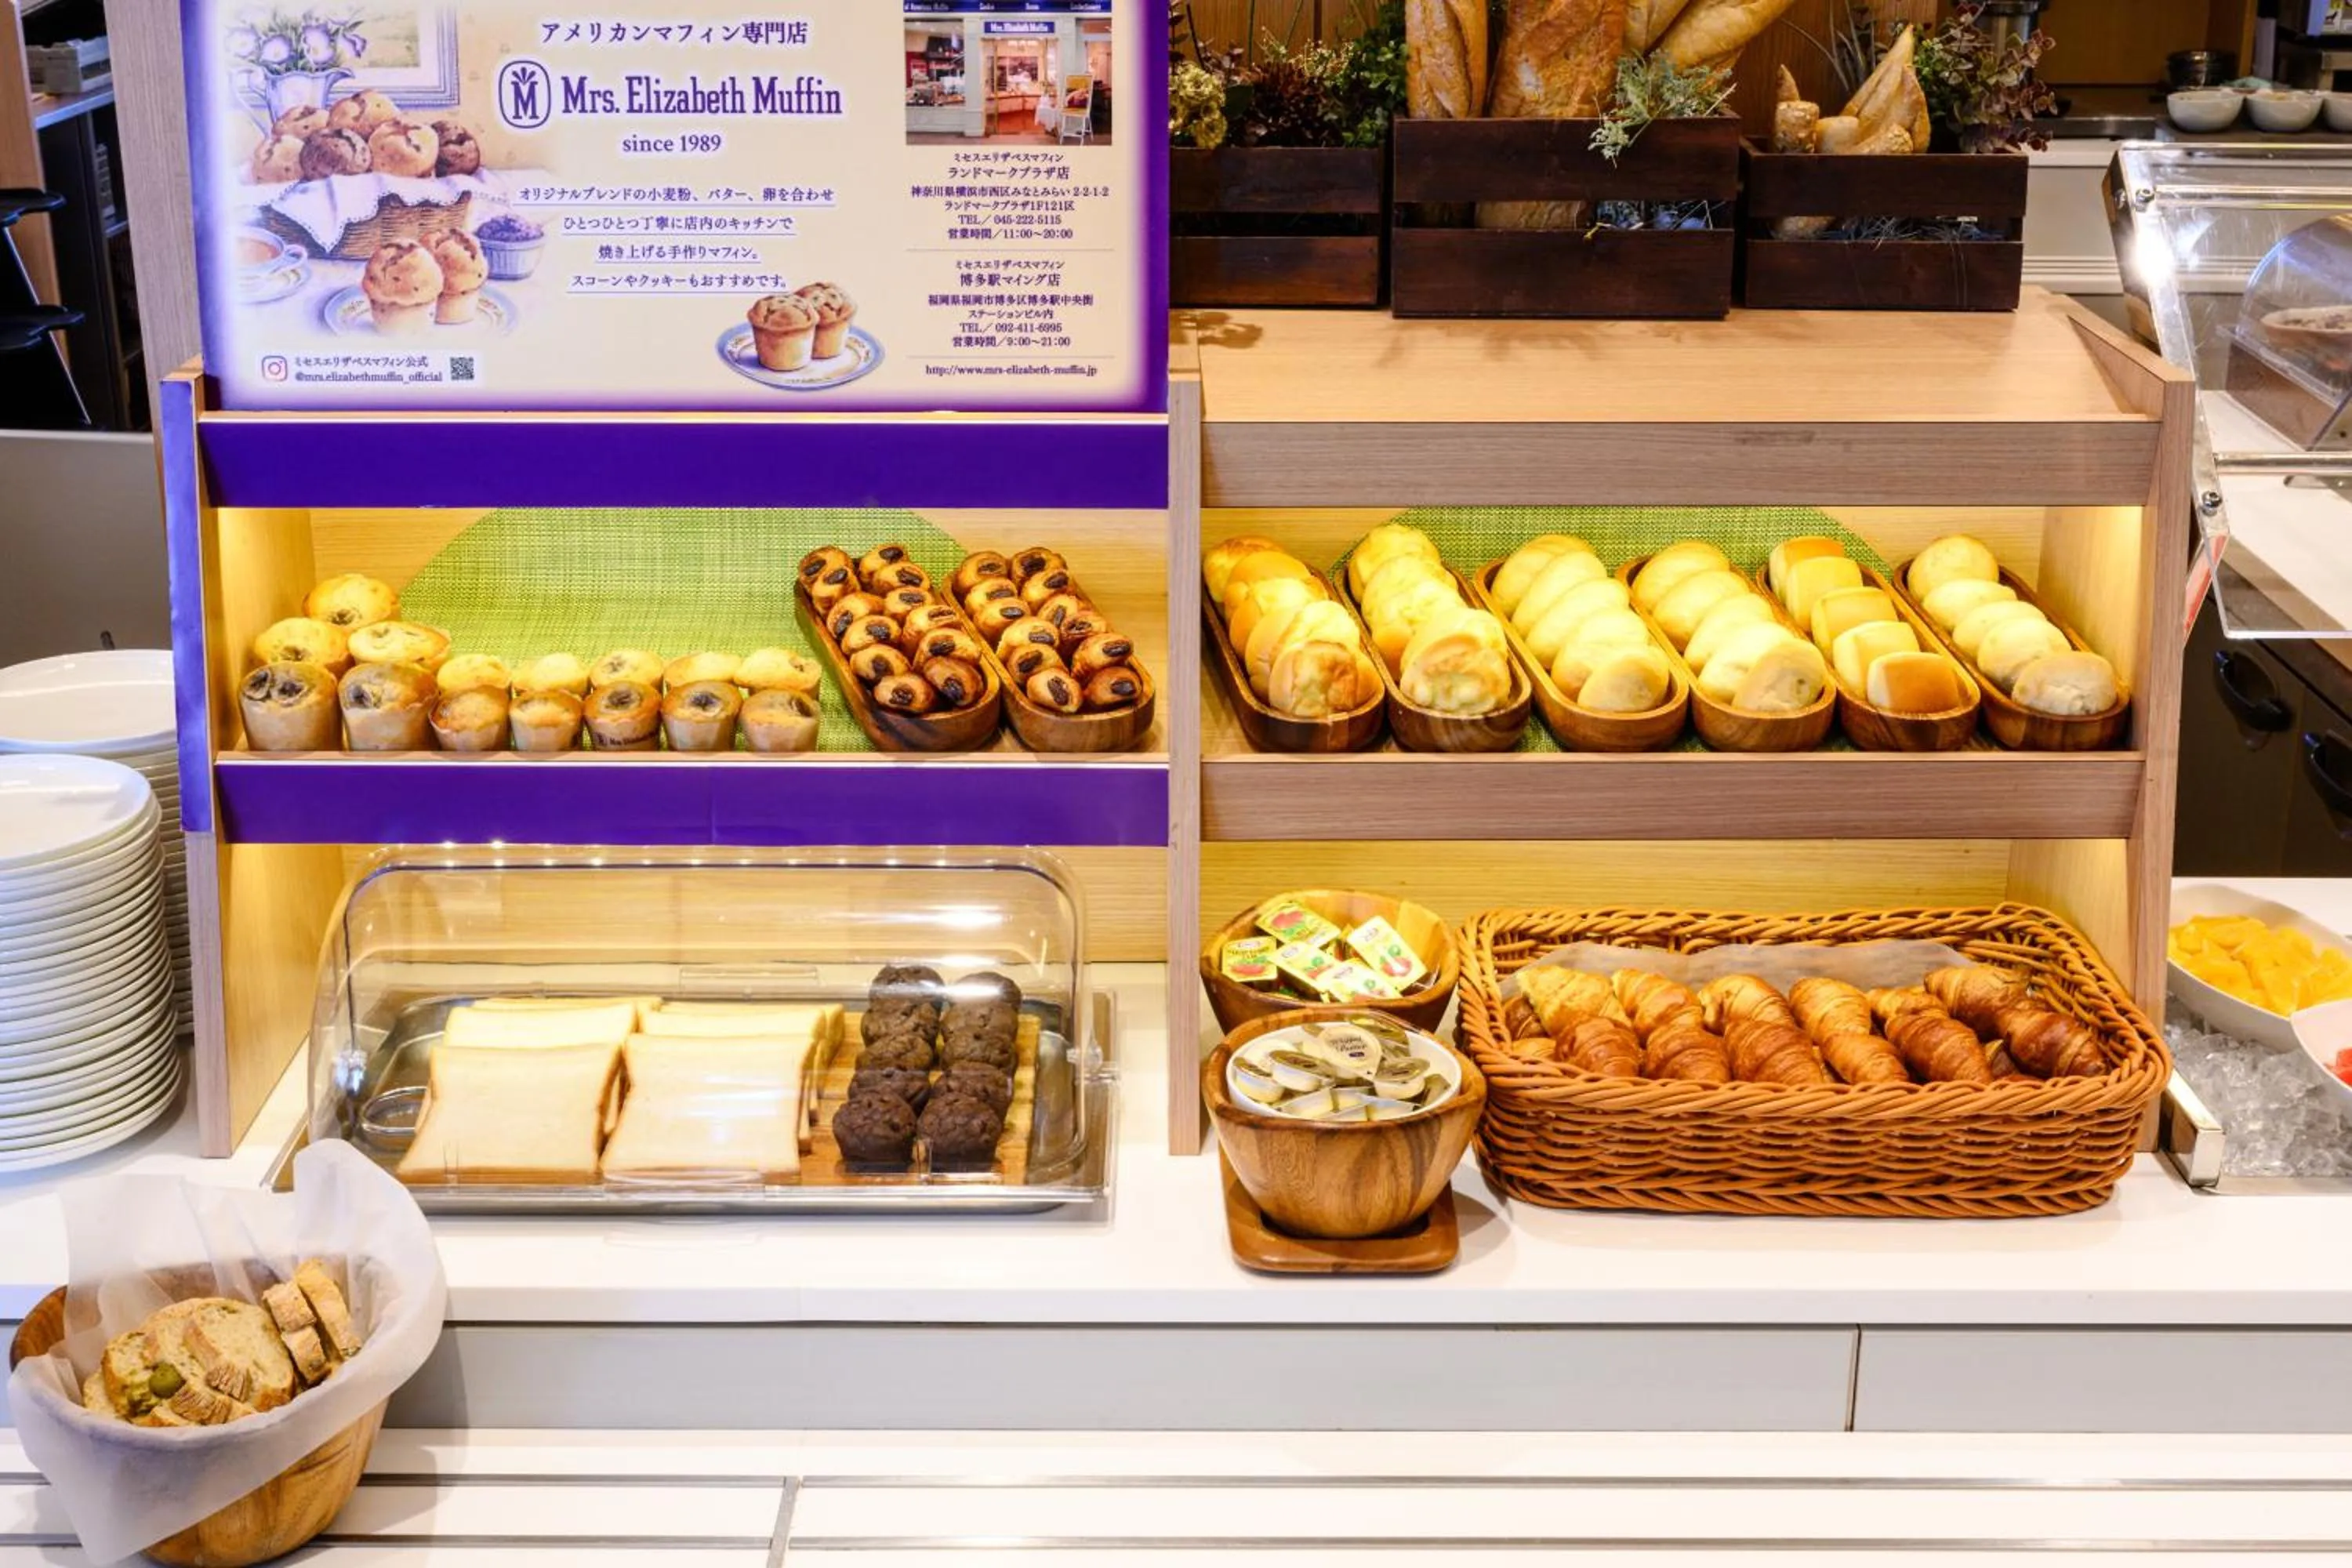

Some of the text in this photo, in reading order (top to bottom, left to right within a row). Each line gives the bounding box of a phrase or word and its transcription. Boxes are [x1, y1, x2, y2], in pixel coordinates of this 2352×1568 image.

[543, 22, 808, 44] アメリカンマフィン専門店
[561, 76, 619, 113] Mrs.
[626, 76, 746, 114] Elizabeth
[753, 77, 842, 114] Muffin
[622, 135, 721, 152] since 1989
[949, 166, 1069, 180] ランドマークプラザ店
[564, 216, 793, 230] ひとつひとつ丁寧に店内のキッチンで
[599, 245, 757, 259] 焼き上げる手作りマフィン。
[573, 274, 786, 287] スコーンやクッキーもおすすめです。
